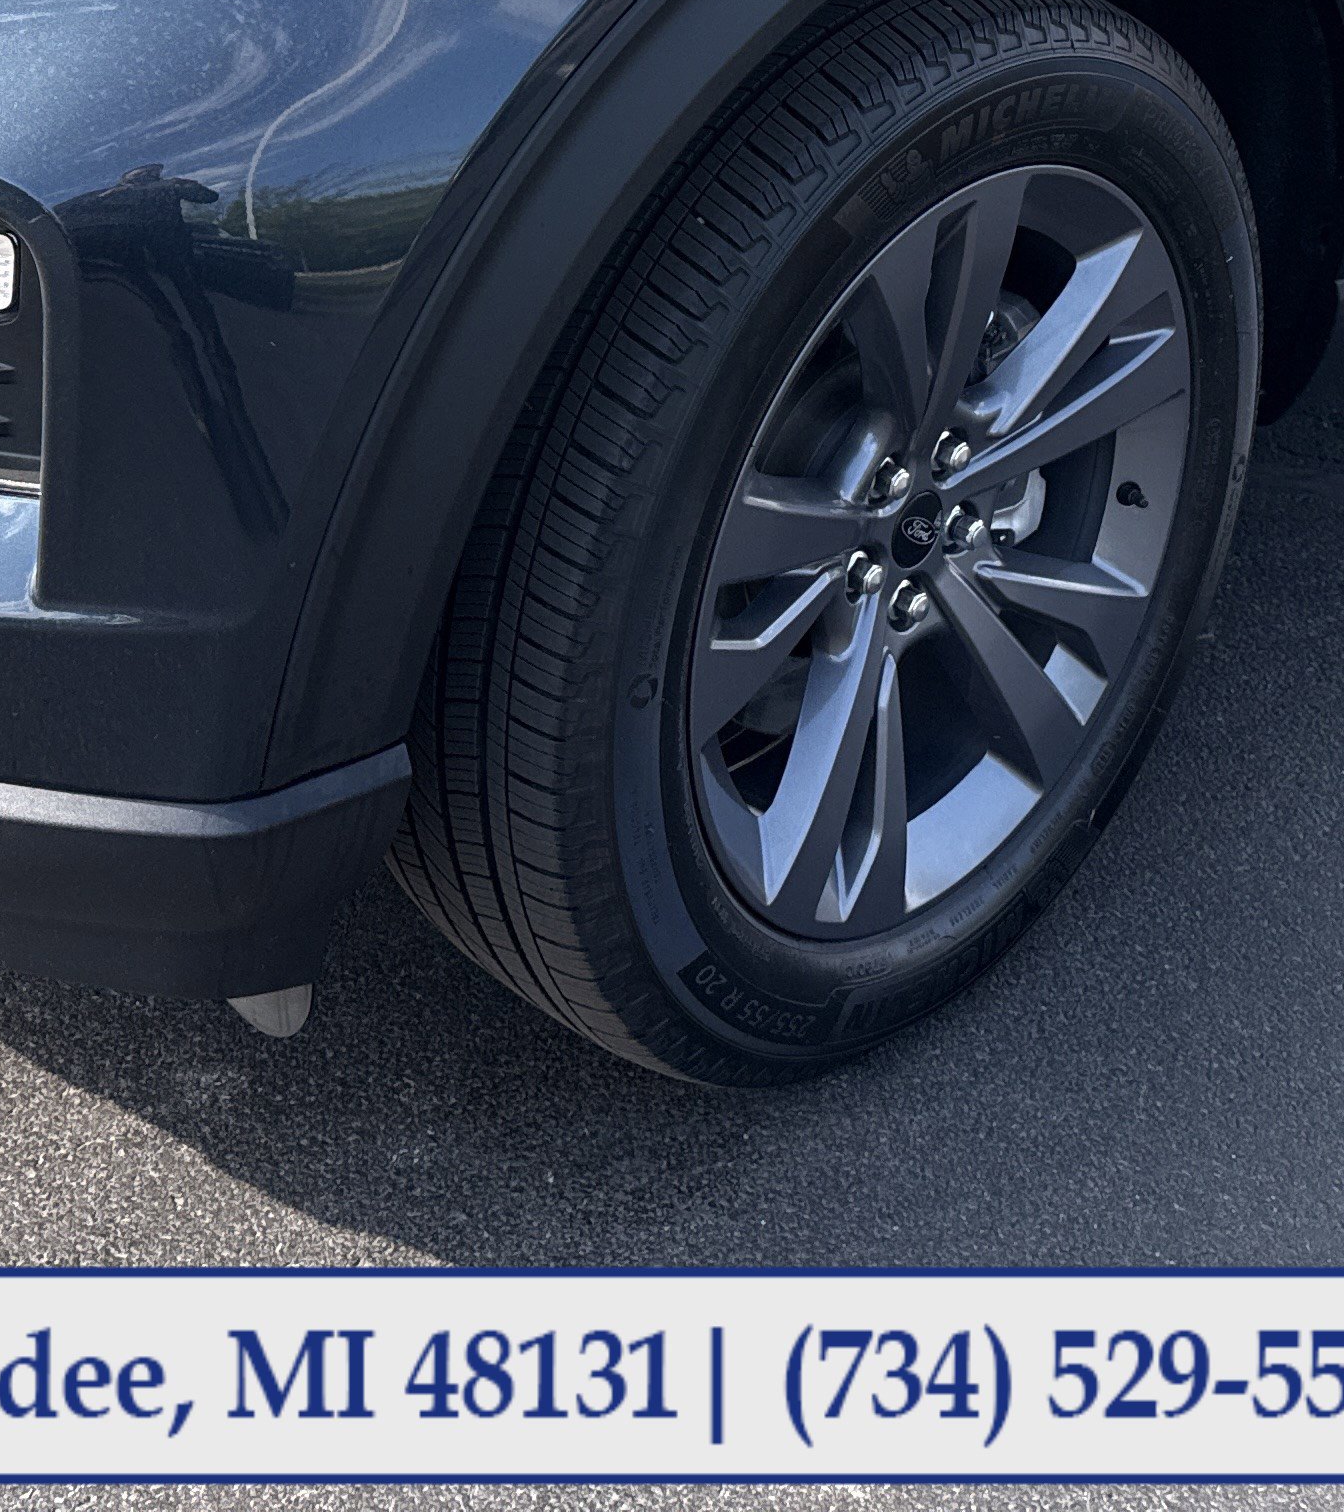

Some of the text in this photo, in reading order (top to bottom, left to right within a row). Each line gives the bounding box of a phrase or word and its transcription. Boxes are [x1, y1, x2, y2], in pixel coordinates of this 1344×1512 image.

[907, 519, 933, 542] Ford
[694, 964, 728, 996] 20
[720, 987, 745, 1011] R
